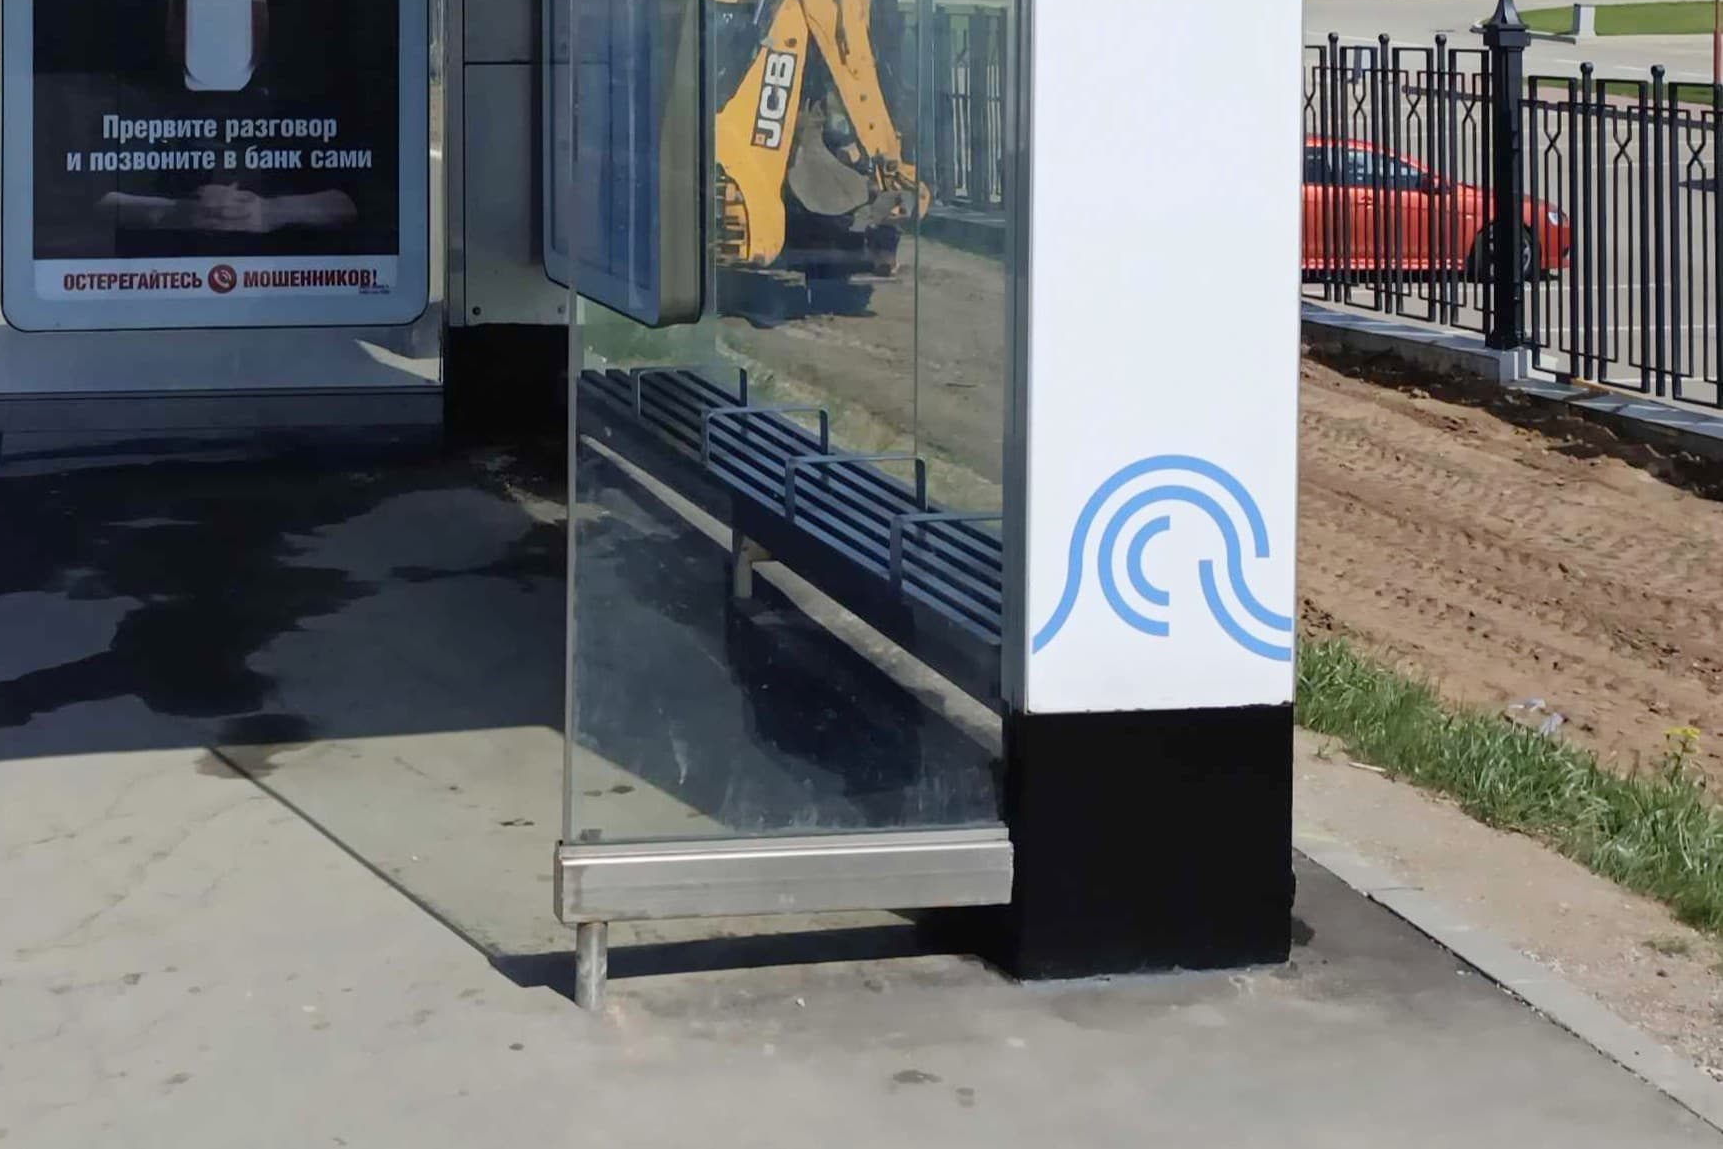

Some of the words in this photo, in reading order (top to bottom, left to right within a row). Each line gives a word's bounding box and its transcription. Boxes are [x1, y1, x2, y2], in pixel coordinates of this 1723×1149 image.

[757, 53, 795, 148] JCB
[102, 114, 217, 144] Прервите
[225, 117, 337, 143] разговор
[67, 153, 81, 171] и
[90, 150, 215, 171] позвоните
[224, 150, 237, 169] в
[245, 145, 302, 169] банк
[310, 150, 372, 168] сами
[63, 269, 202, 291] ОСТЕРЕГАЙТЕСЬ
[243, 268, 377, 288] МОШЕННИКОВ!
